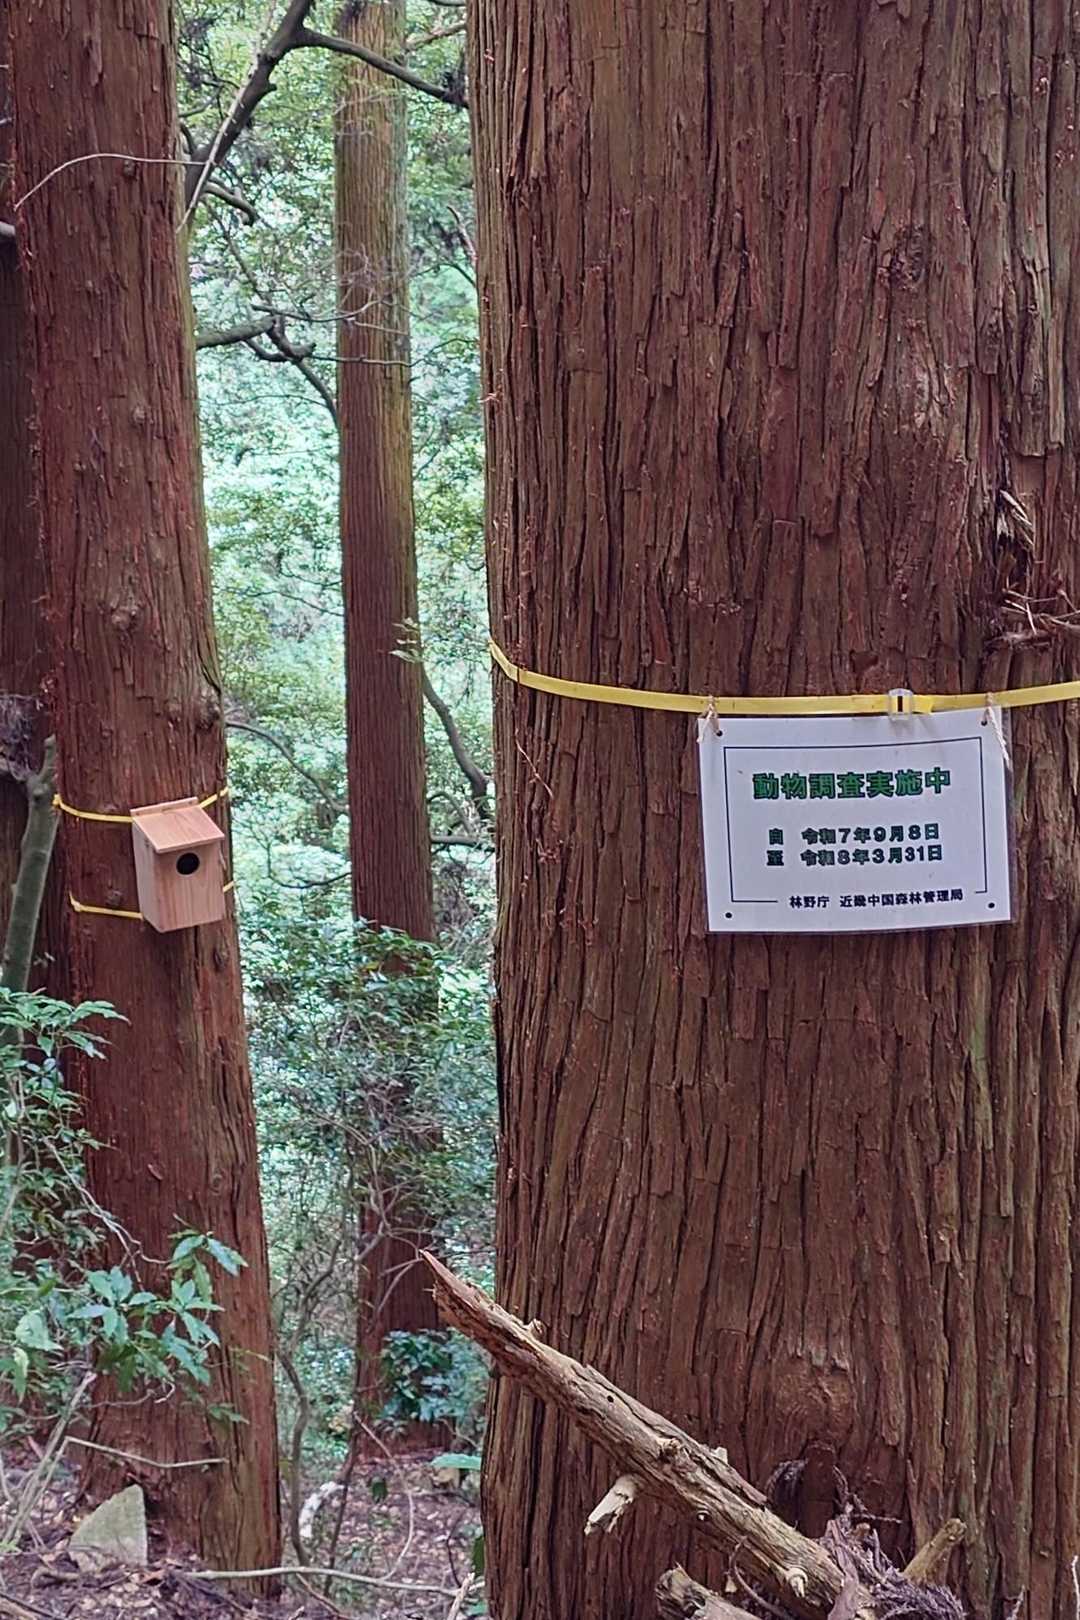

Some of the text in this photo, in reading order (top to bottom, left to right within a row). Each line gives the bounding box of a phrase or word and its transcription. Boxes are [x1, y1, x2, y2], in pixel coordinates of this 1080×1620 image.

[752, 767, 951, 800] 動物調査実施中
[768, 823, 939, 845] 自 令和7年9月8日
[766, 845, 942, 866] 至 令和8年3月31日
[789, 889, 963, 909] 林野庁 近畿中国森林管理局
